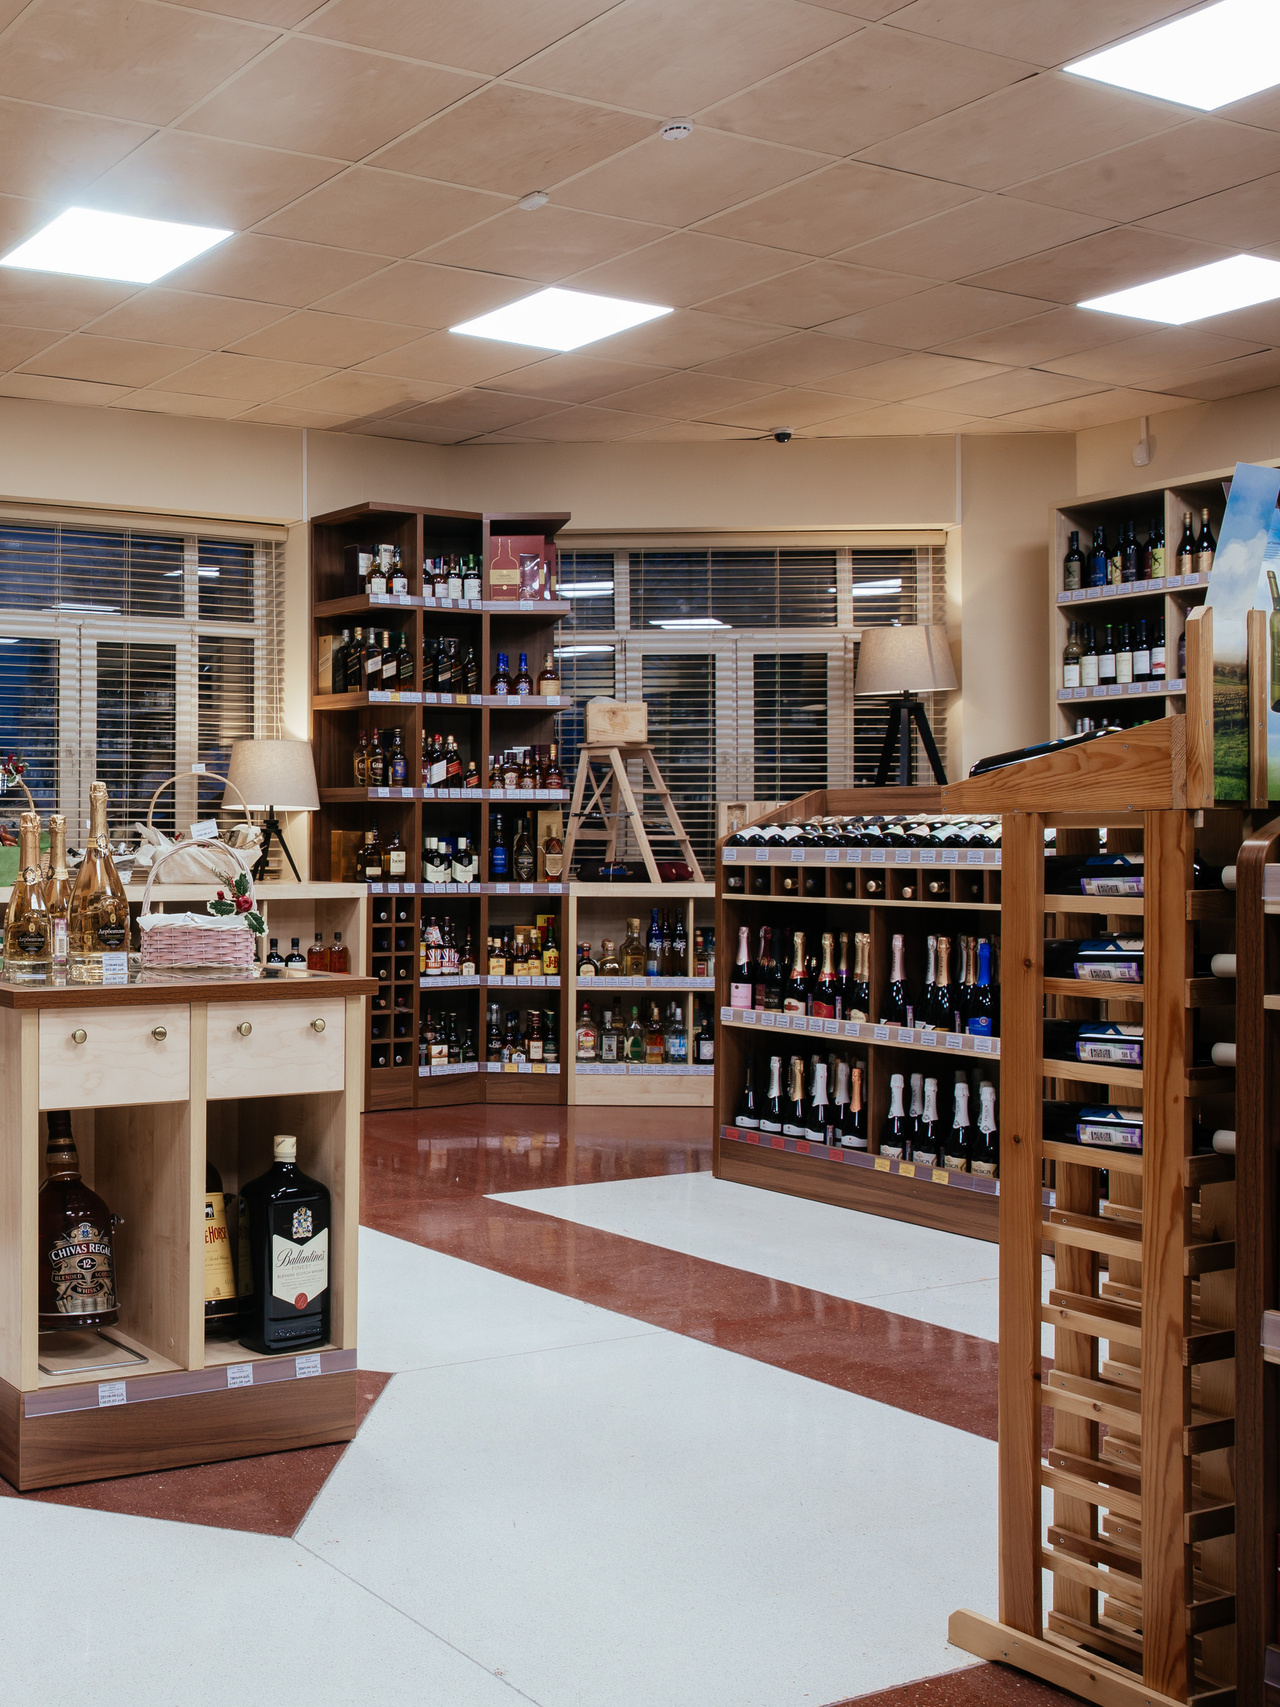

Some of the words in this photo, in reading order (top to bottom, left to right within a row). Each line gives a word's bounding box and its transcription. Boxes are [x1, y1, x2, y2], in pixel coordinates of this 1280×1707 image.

[208, 1226, 228, 1244] HORSE
[51, 1243, 88, 1261] CHIVAS
[88, 1243, 112, 1256] REGAL
[82, 1258, 92, 1268] 12
[291, 1263, 312, 1271] FINEST
[54, 1273, 83, 1281] BLENDED
[76, 1286, 101, 1294] WHISKY
